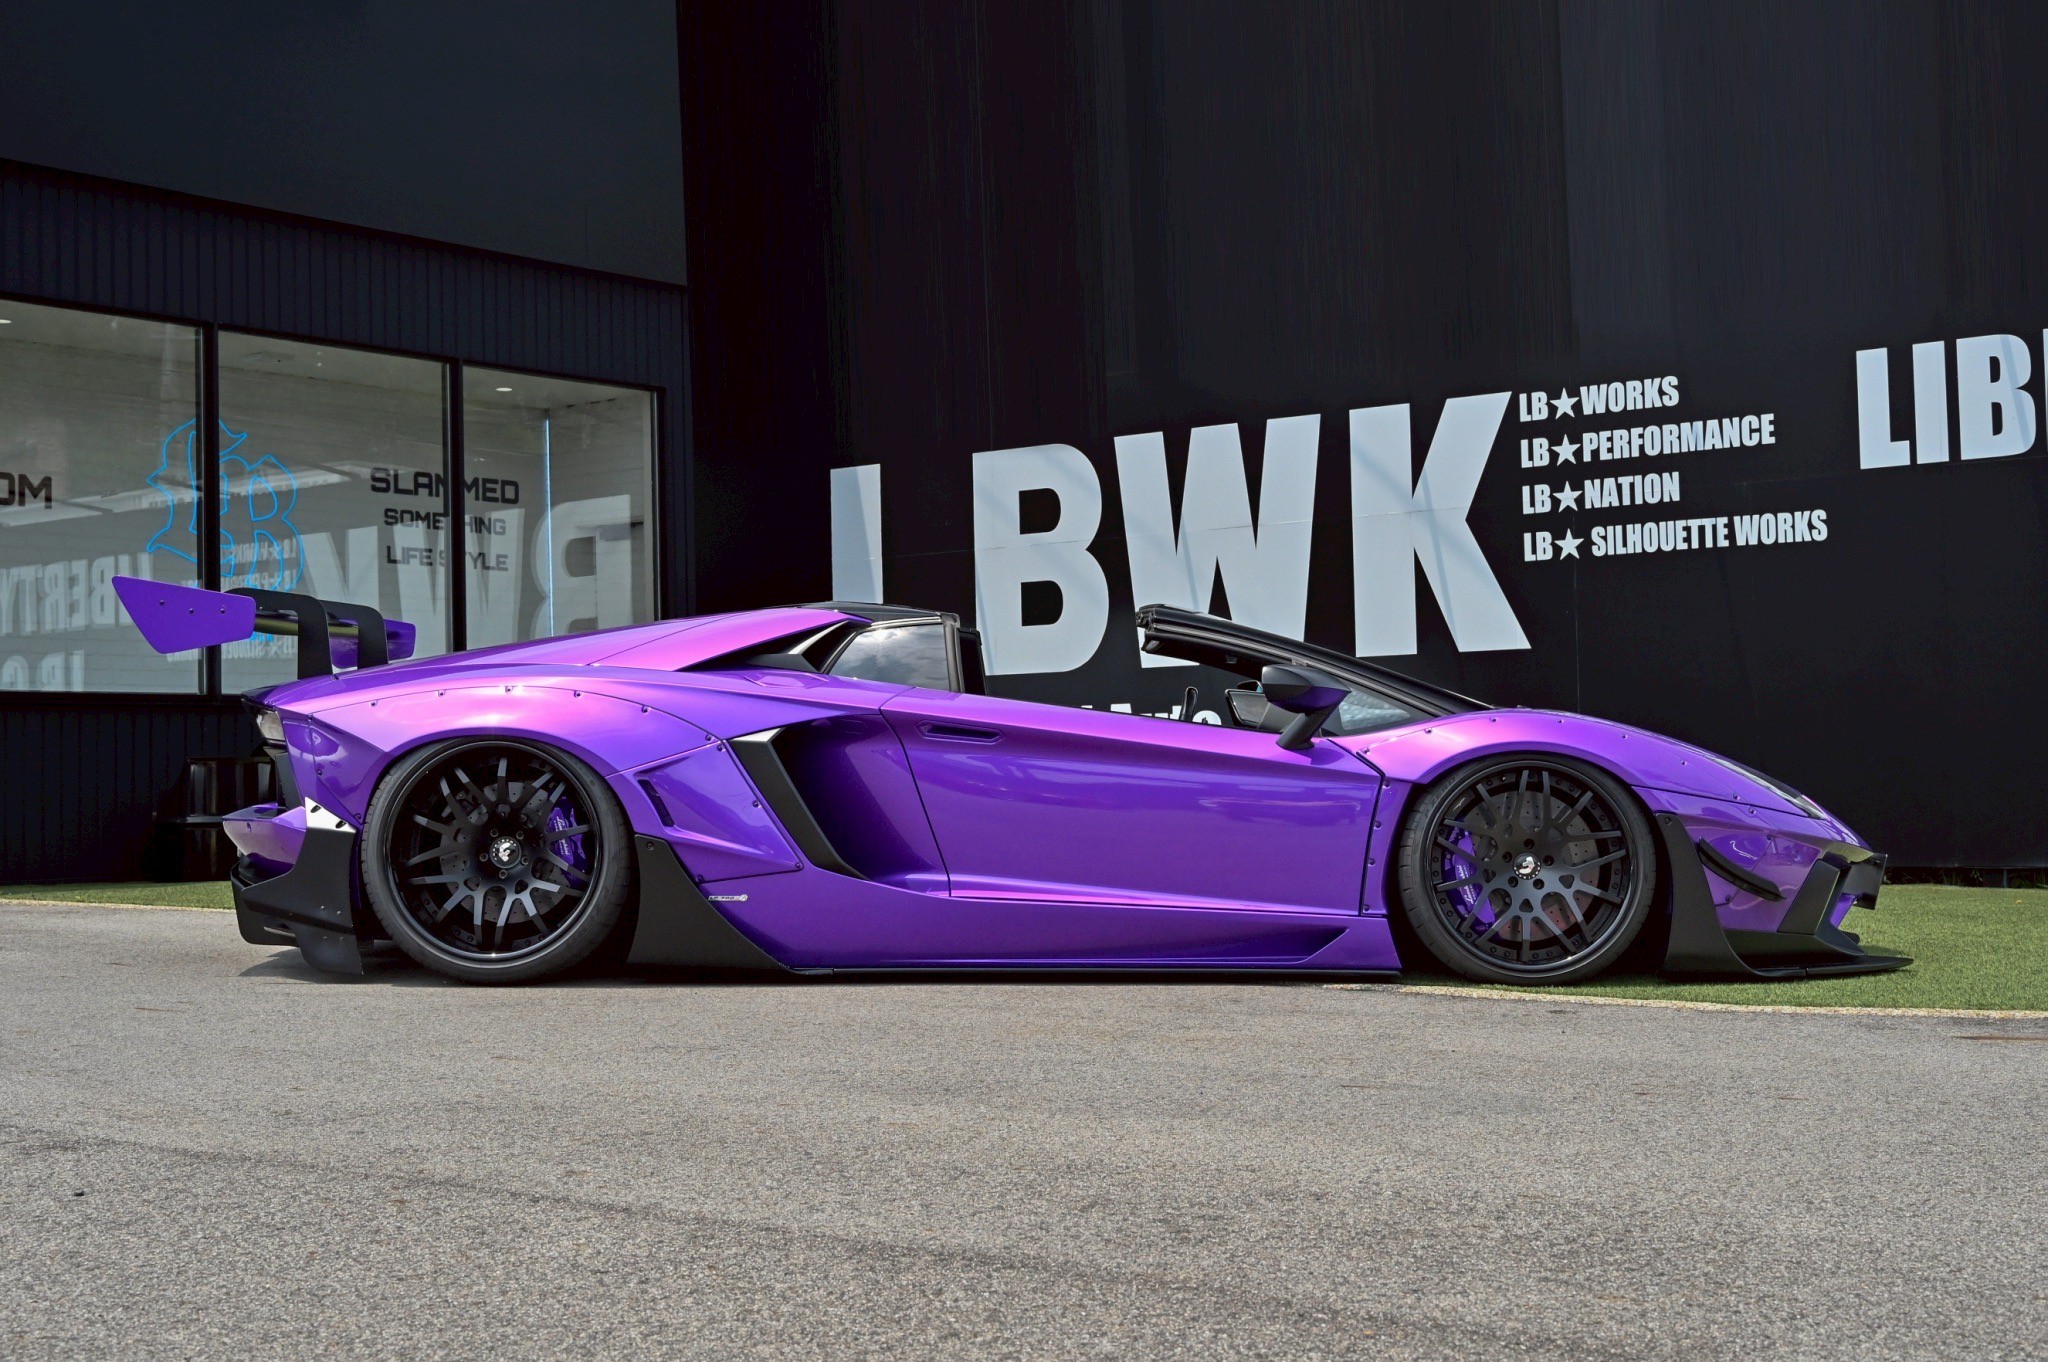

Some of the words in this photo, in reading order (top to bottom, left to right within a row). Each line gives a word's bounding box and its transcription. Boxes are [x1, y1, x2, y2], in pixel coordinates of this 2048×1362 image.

[1519, 391, 1549, 423] LB
[1579, 375, 1680, 416] WORKS
[1856, 328, 2048, 470] LIB
[1520, 437, 1550, 469] LB
[1582, 413, 1776, 463] PERFORMANCE
[1521, 483, 1552, 515] LB
[1584, 471, 1681, 510] NATION
[384, 507, 507, 537] SOMEHING
[1523, 530, 1553, 562] LB
[1591, 516, 1729, 558] SILHOUETTE
[1733, 508, 1828, 547] WORKS
[386, 545, 433, 567] LIFE
[439, 548, 509, 572] YLE
